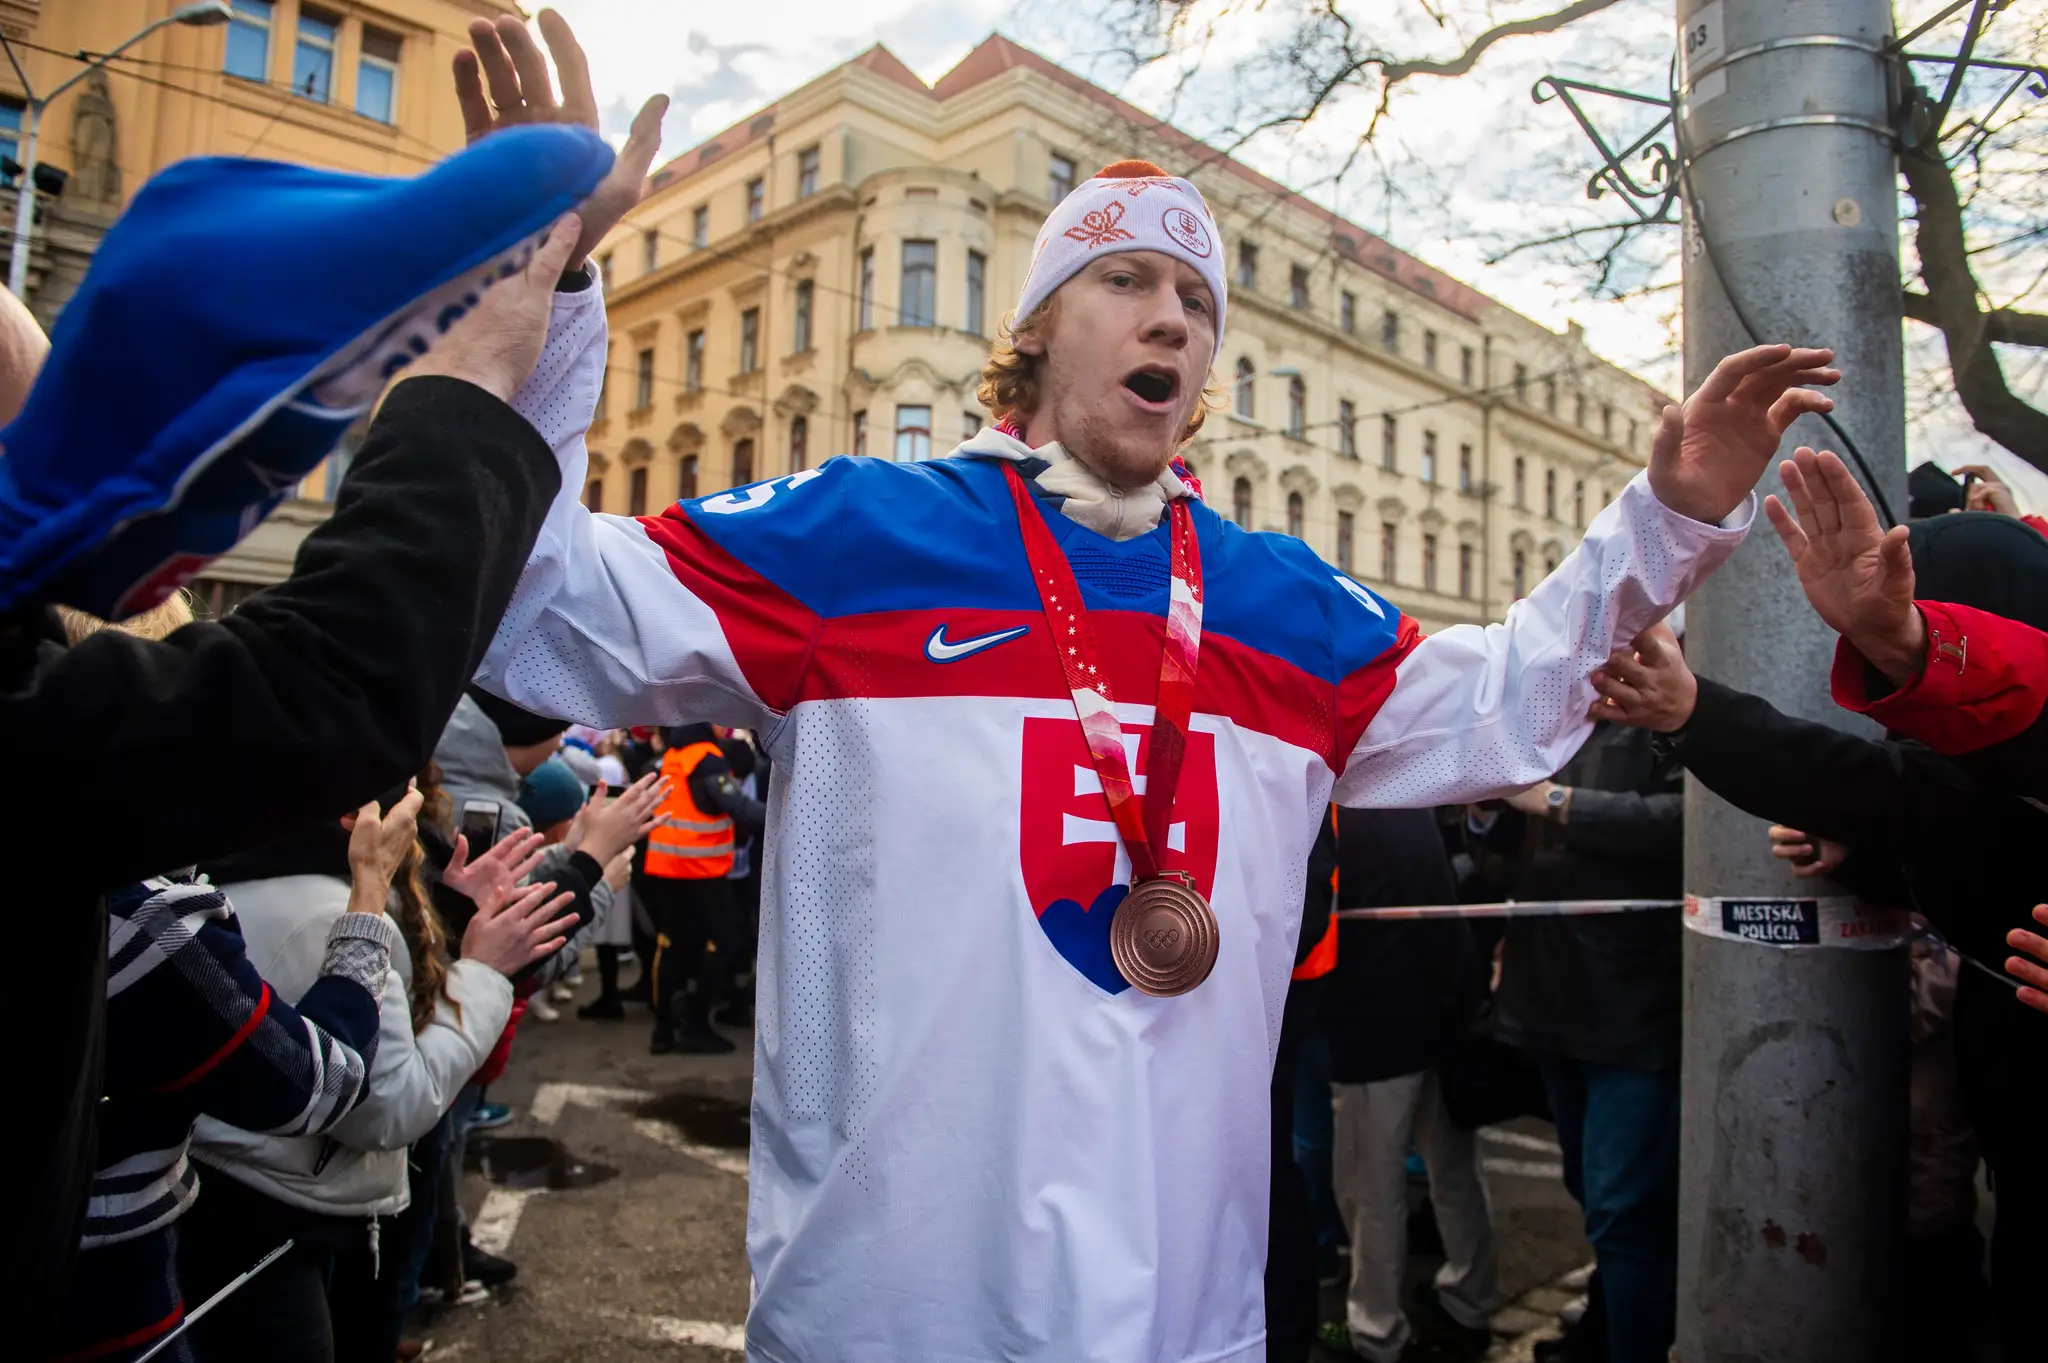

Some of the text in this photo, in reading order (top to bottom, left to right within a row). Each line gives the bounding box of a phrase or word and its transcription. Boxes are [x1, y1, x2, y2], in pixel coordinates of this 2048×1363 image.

[1171, 226, 1206, 248] SLOVAKIA
[1732, 903, 1804, 922] MESTSKÁ
[1738, 921, 1801, 941] POLÍCIA
